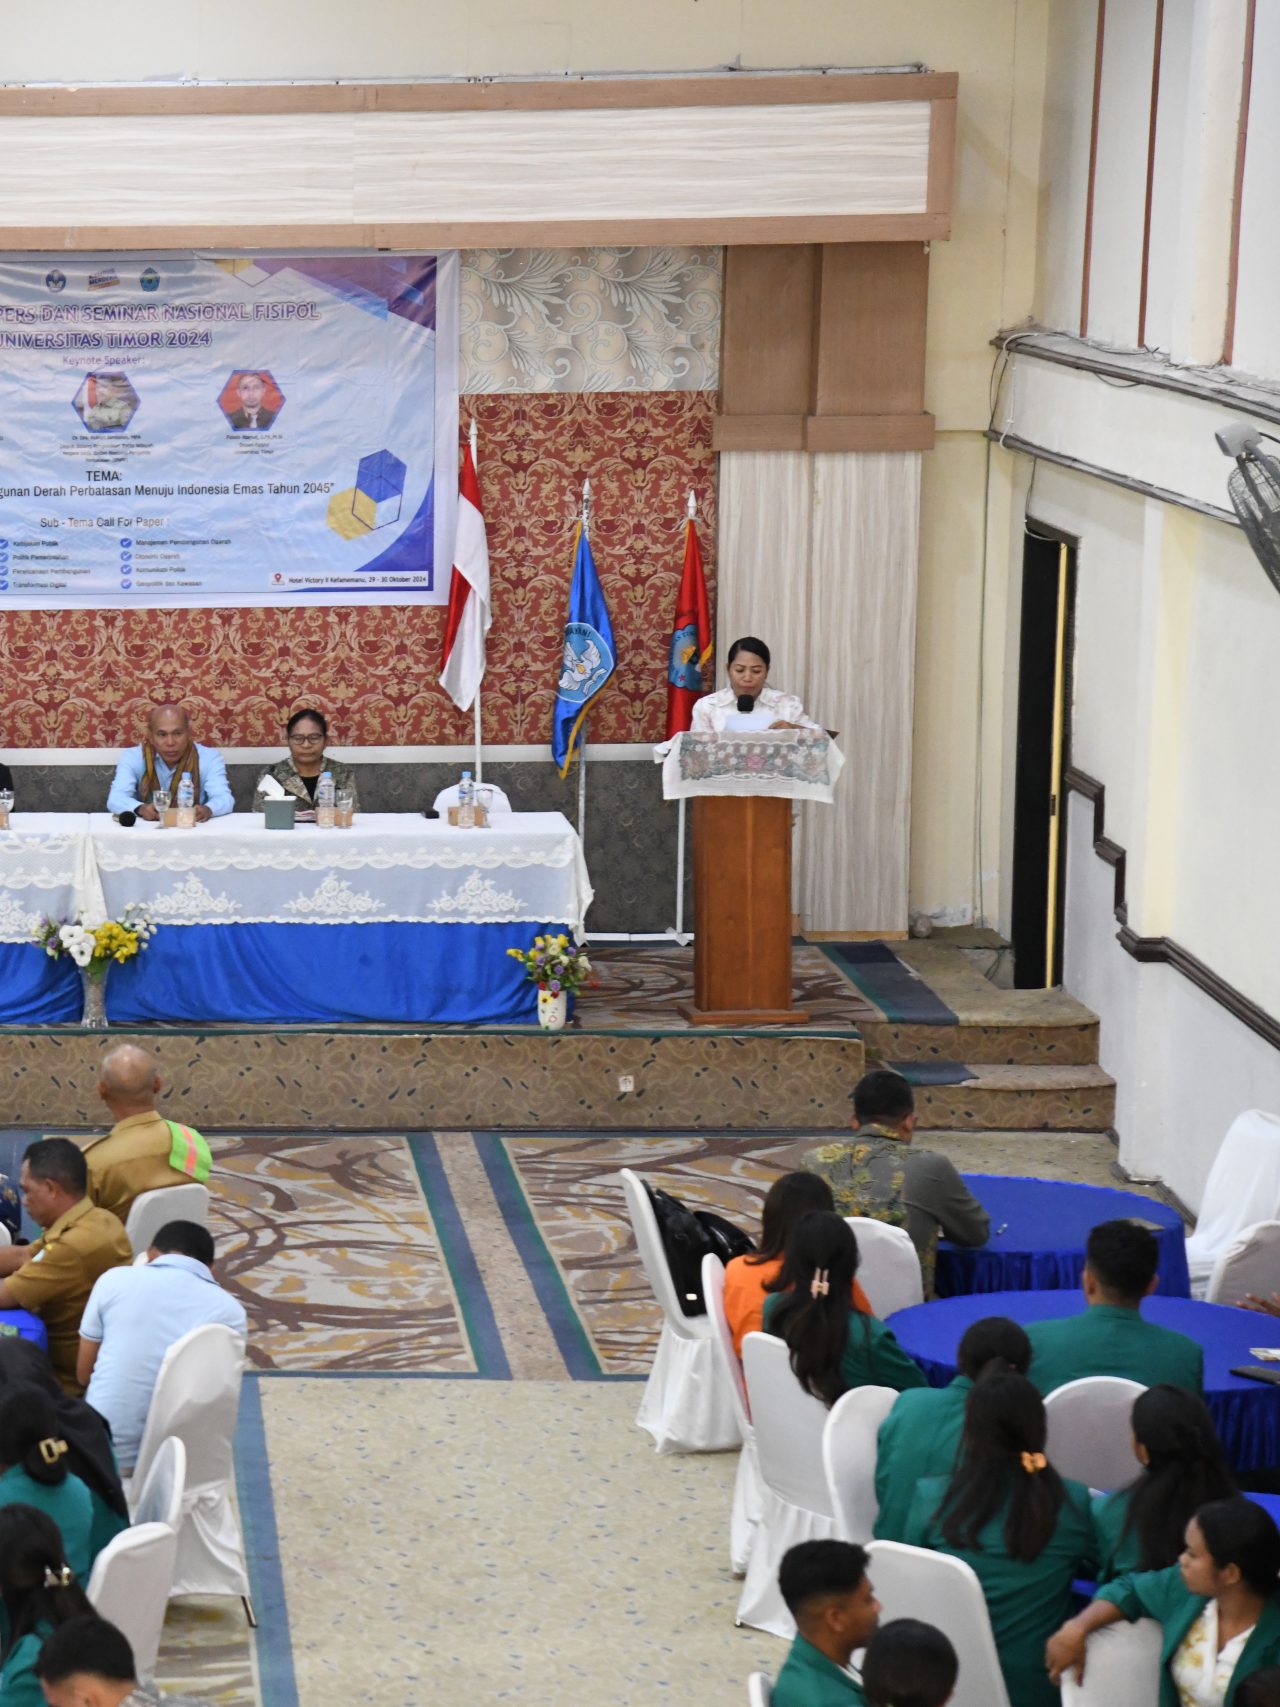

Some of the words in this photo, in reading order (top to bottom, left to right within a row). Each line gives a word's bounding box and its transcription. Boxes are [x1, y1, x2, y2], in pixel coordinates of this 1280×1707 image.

[39, 304, 80, 323] DAN
[81, 303, 160, 322] SEMINAR
[162, 303, 249, 321] NASIONAL
[253, 302, 320, 320] FISIPOL
[107, 330, 162, 348] TIMOR
[167, 329, 212, 348] 2024
[63, 355, 101, 367] Keynote
[104, 354, 145, 366] Speaker:
[86, 470, 122, 481] TEMA:
[34, 485, 66, 497] Derah
[70, 485, 131, 497] Perbatasan
[134, 484, 174, 498] Menuju
[177, 484, 229, 495] Indonesia
[233, 483, 263, 495] Emas
[268, 483, 300, 494] Tahun
[40, 517, 59, 527] Sub
[68, 517, 94, 527] Tema
[96, 516, 115, 527] Call
[117, 516, 132, 527] For
[136, 516, 164, 528] Paper
[305, 577, 324, 585] Victory
[389, 575, 411, 583] Oktober
